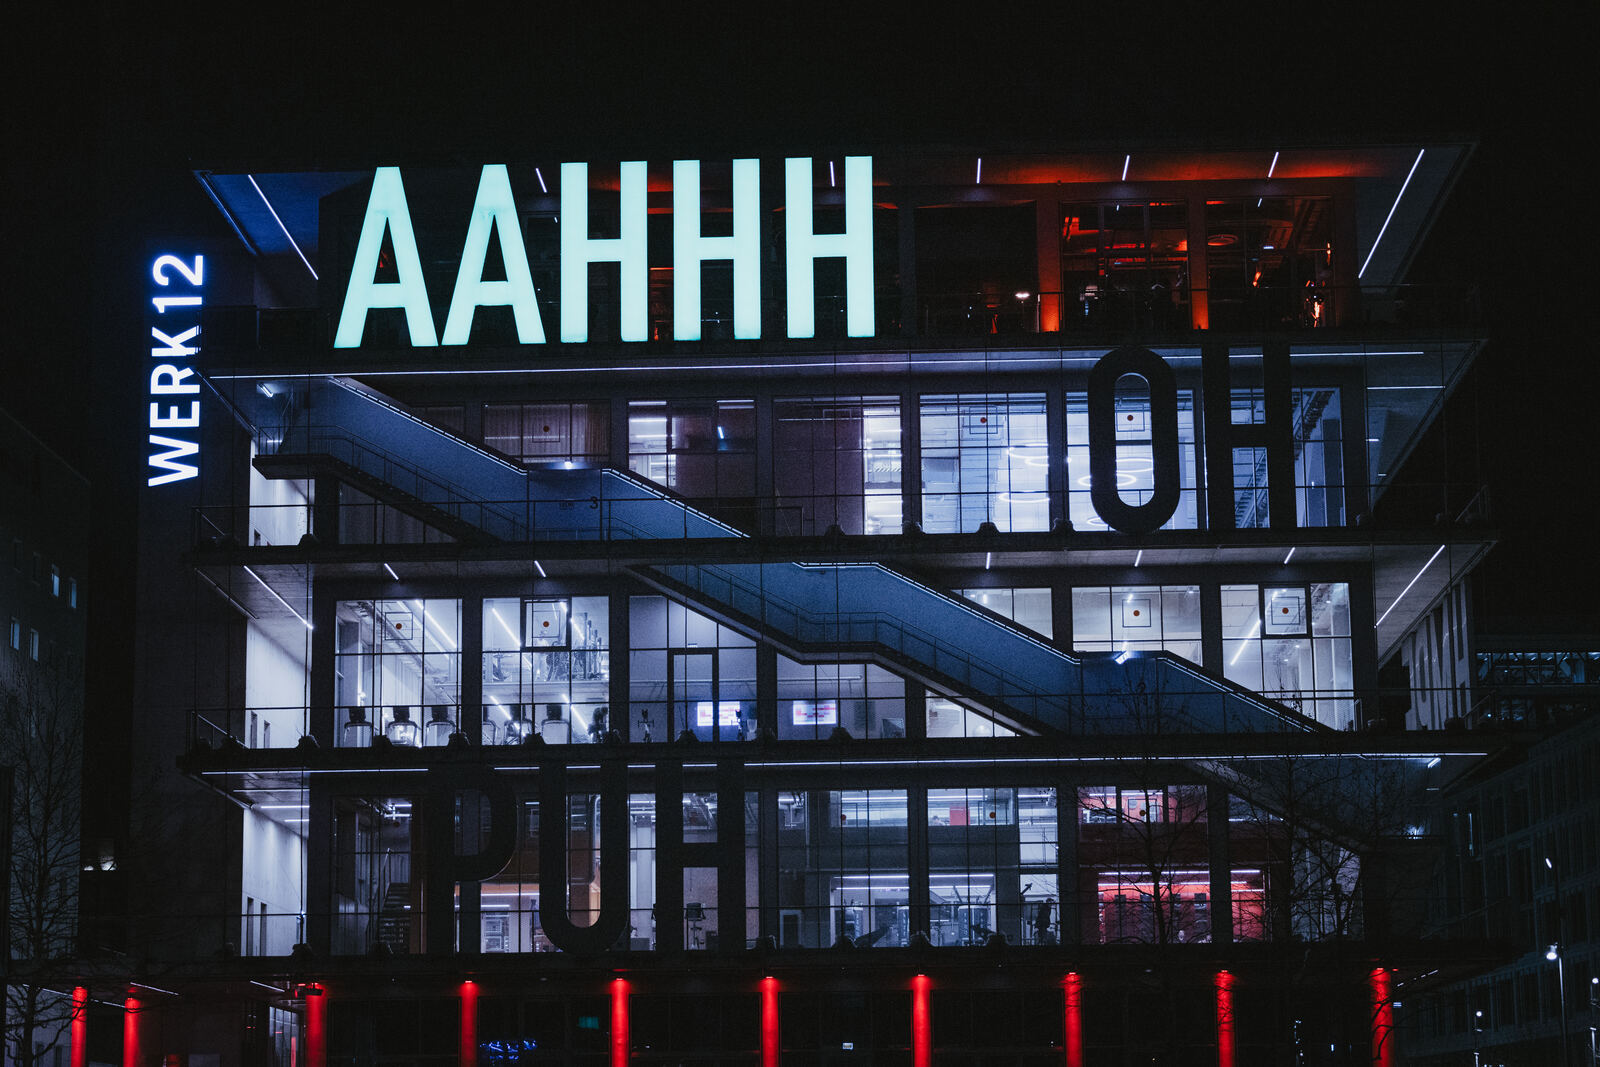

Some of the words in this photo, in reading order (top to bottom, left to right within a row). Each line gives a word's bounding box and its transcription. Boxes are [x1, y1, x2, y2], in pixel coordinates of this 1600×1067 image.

[151, 253, 205, 314] 12
[334, 156, 875, 349] AAHHH
[148, 325, 202, 487] WERK
[1087, 344, 1298, 535] OH
[589, 496, 599, 509] 3
[428, 757, 745, 954] PUH
